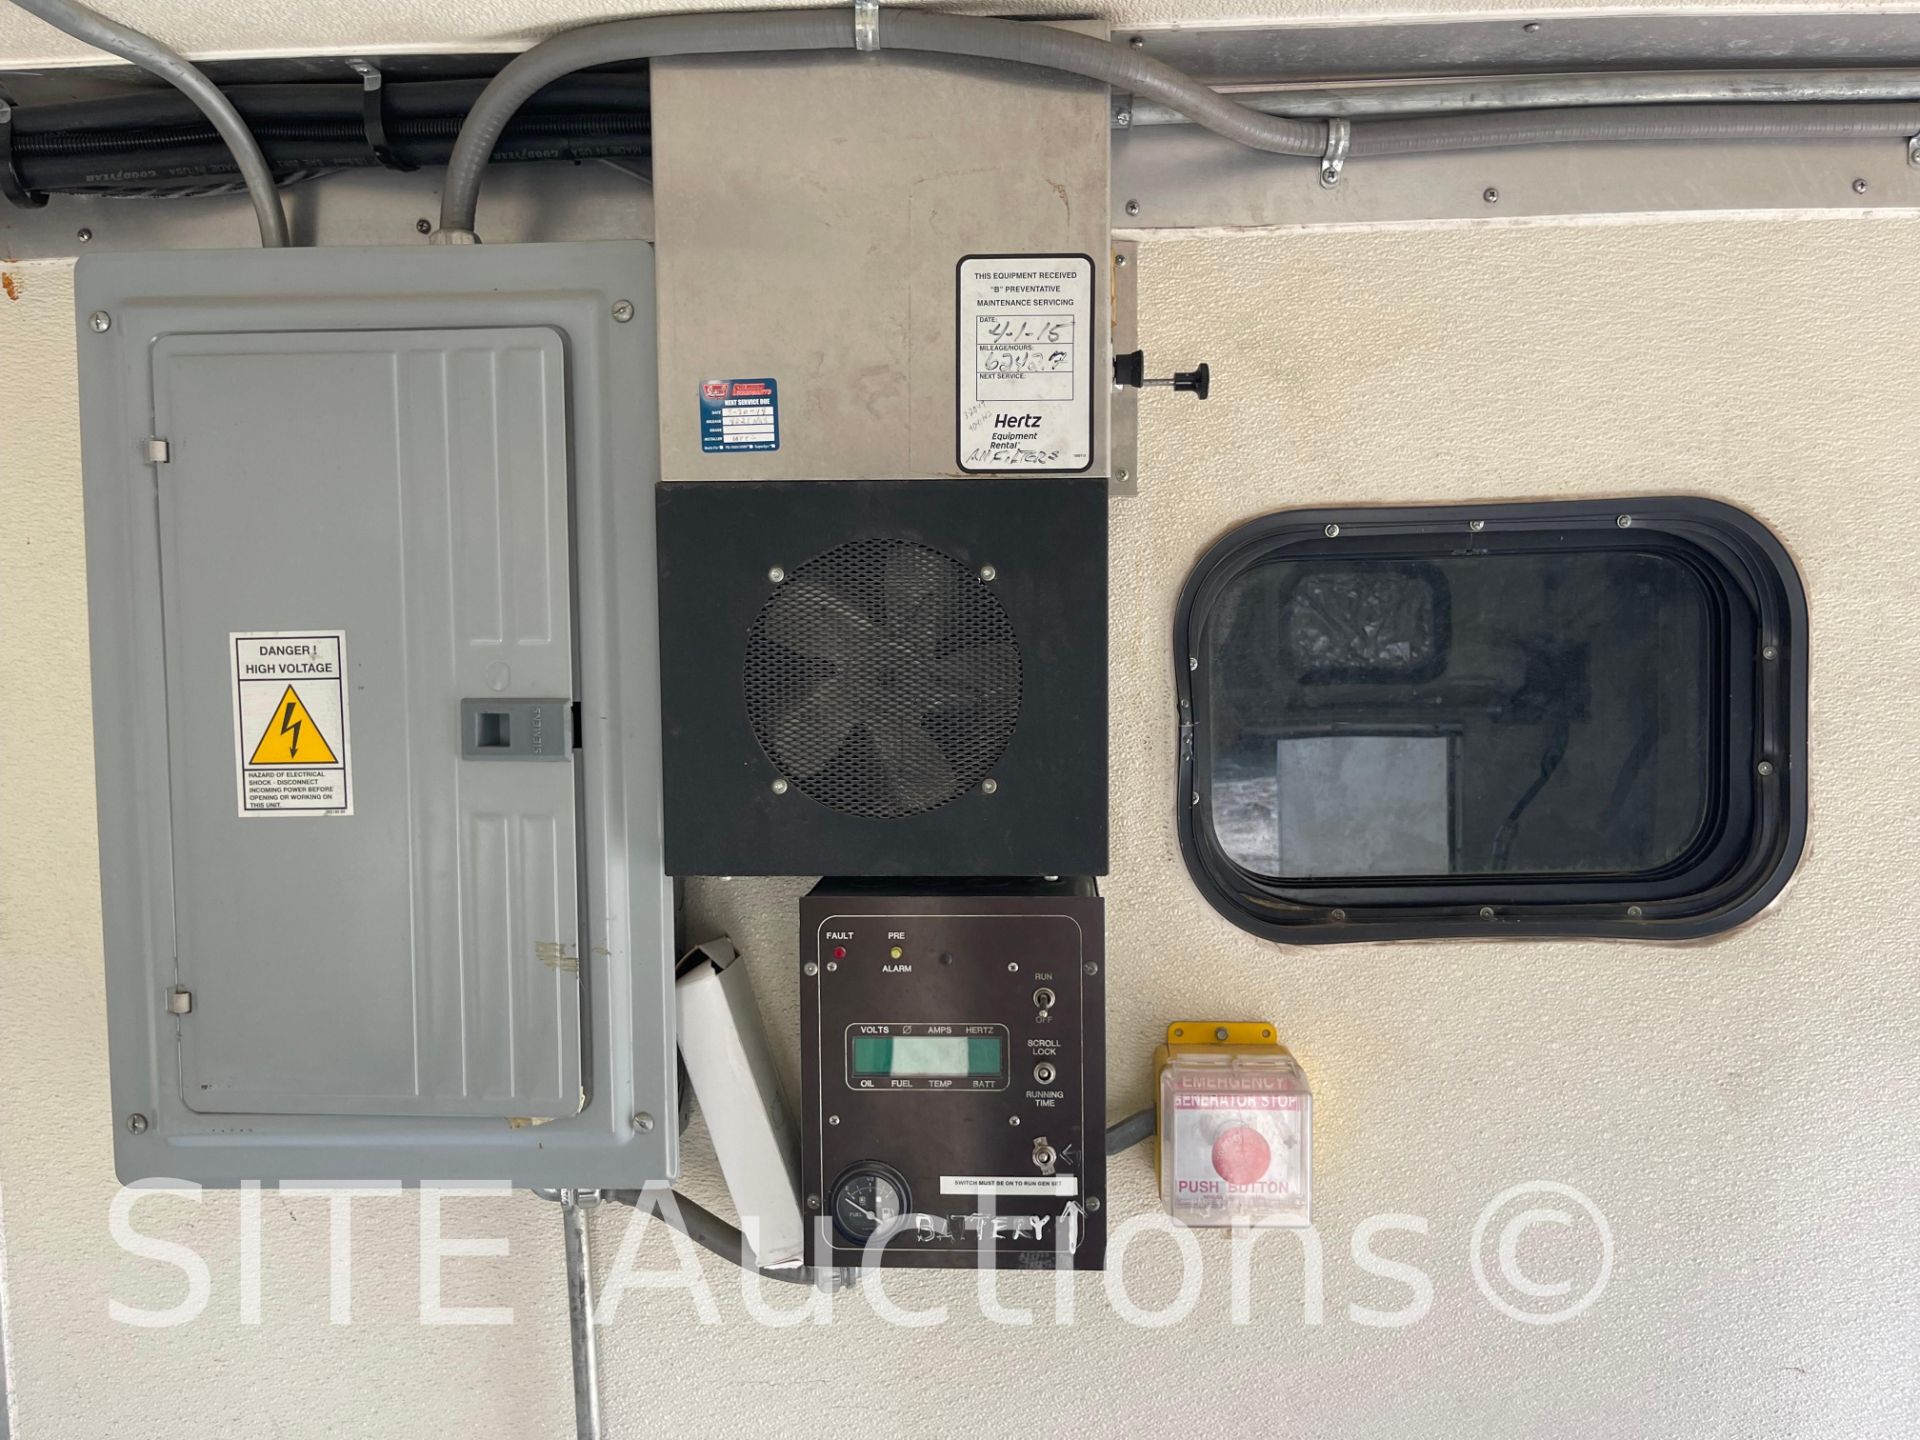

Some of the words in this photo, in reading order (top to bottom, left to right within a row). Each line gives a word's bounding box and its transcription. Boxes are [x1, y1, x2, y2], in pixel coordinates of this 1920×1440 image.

[975, 272, 992, 280] THIS
[993, 272, 1037, 280] EQUIPMENT
[1039, 271, 1077, 280] RECEIVED
[1005, 285, 1061, 293] PREVENTATIVE
[977, 299, 1032, 307] MAINTENANCE
[1033, 299, 1074, 307] SERVICING
[994, 413, 1042, 428] Hertz
[991, 432, 1038, 441] Equipment
[259, 645, 311, 656] DANGER
[246, 664, 276, 674] HIGH
[278, 663, 333, 673] VOLTAGE
[532, 706, 543, 754] SIEMENS
[826, 932, 854, 940] FAULT
[887, 932, 906, 940] PRE
[882, 964, 912, 973] ALARM
[1034, 972, 1053, 980] RUN
[860, 1026, 890, 1034] VOLTS
[927, 1026, 953, 1034] AMPS
[965, 1026, 995, 1034] HERTZ
[1027, 1039, 1061, 1047] SCROLL
[1032, 1048, 1057, 1056] LOCK
[860, 1080, 875, 1088] OIL
[890, 1080, 913, 1088] FUEL
[928, 1080, 953, 1088] TEMP
[972, 1080, 997, 1088] BATT
[1182, 1075, 1284, 1090] EMERGENCY
[1025, 1090, 1064, 1098] RUNNING
[1034, 1099, 1056, 1107] TIME
[1175, 1095, 1259, 1107] GENERATOR
[1261, 1095, 1298, 1107] STOP
[1178, 1180, 1219, 1193] PUSH
[1228, 1180, 1289, 1194] BUTTON
